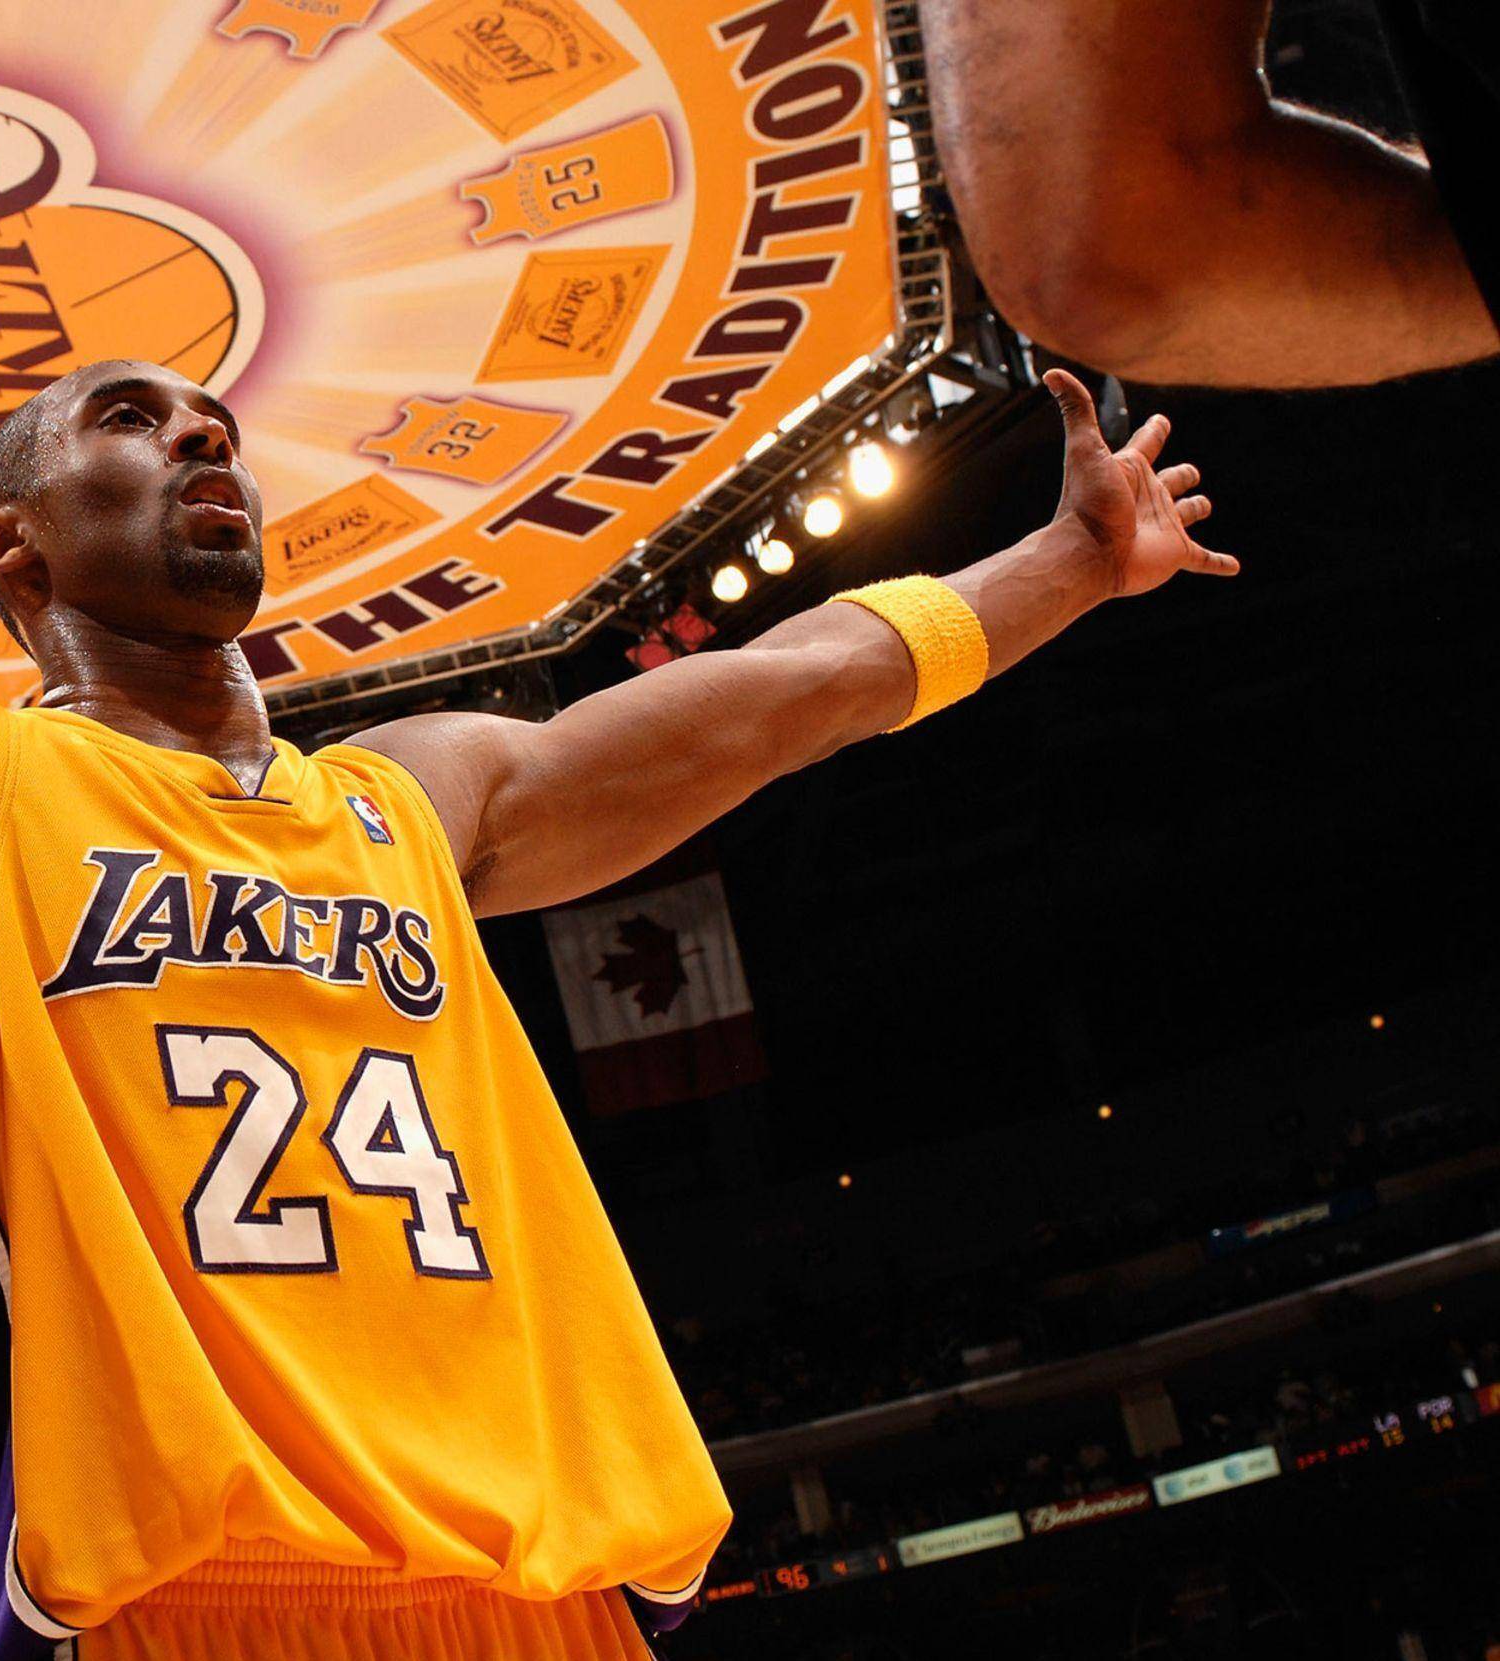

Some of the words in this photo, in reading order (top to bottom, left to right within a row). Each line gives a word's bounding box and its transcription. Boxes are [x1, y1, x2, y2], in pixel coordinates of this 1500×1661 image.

[467, 13, 558, 84] LAKERS
[543, 156, 602, 211] 25
[475, 0, 872, 541] TRADITION
[538, 275, 603, 349] LAKERS
[426, 420, 500, 461] 32
[283, 504, 372, 561] LAKERS
[234, 556, 507, 682] THE
[41, 847, 447, 1022] LAKERS
[154, 1023, 493, 1281] 24
